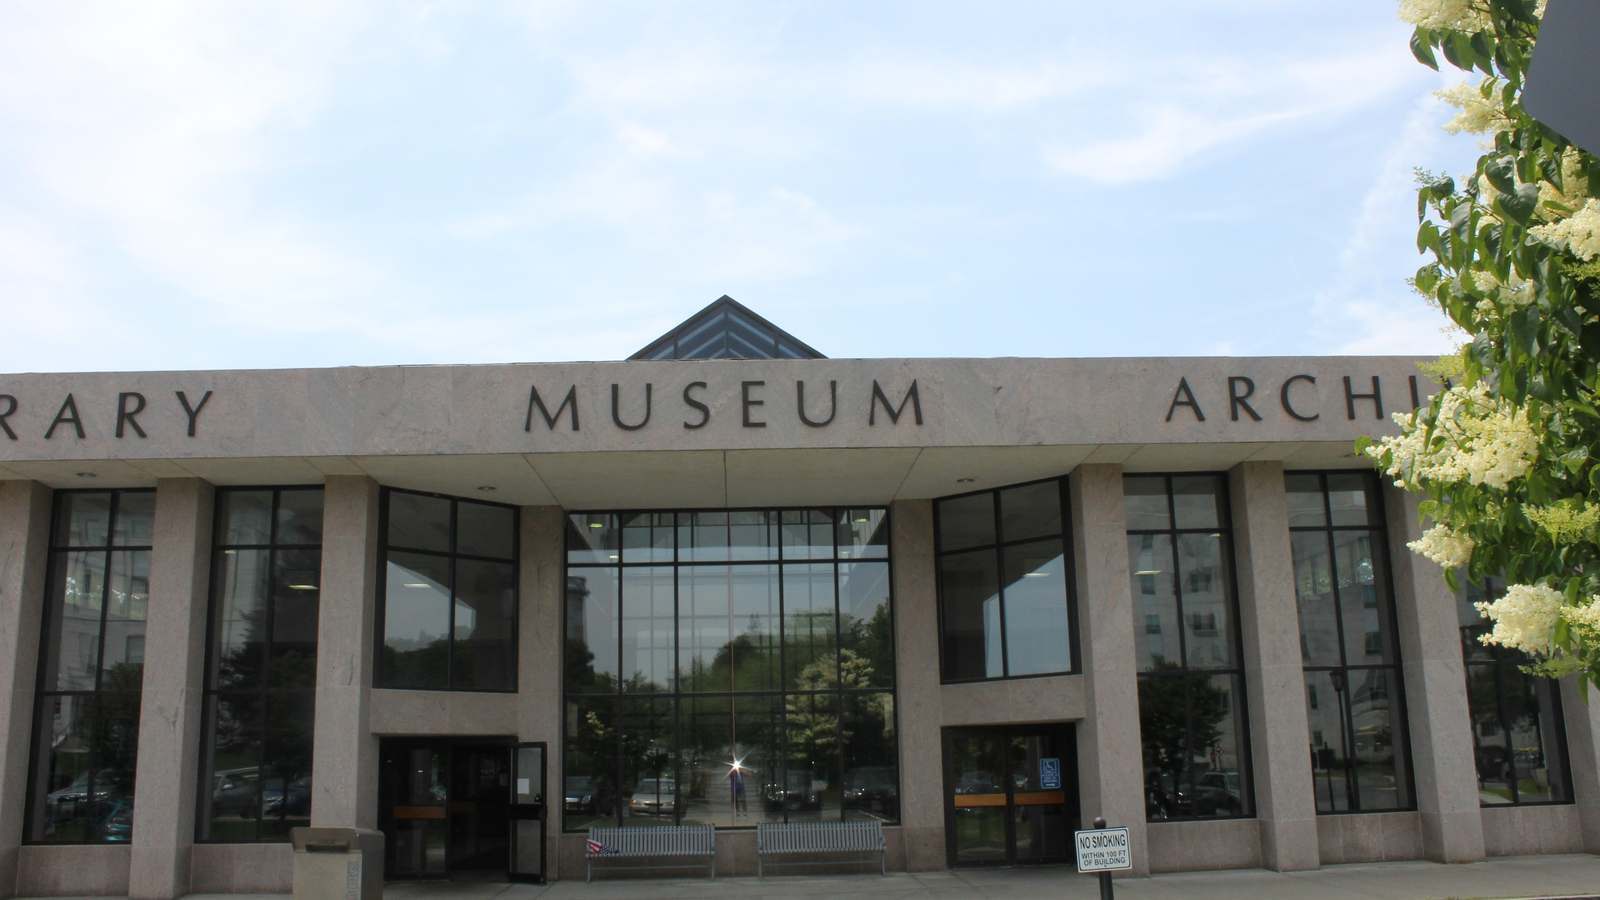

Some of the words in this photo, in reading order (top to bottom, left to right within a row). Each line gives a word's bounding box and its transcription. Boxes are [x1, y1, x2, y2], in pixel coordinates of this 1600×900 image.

[524, 378, 923, 432] MUSEUM
[1166, 375, 1452, 422] ARCHI
[1080, 837, 1090, 849] NO
[1092, 834, 1126, 848] SMOKING
[1095, 857, 1126, 866] BUILDING
